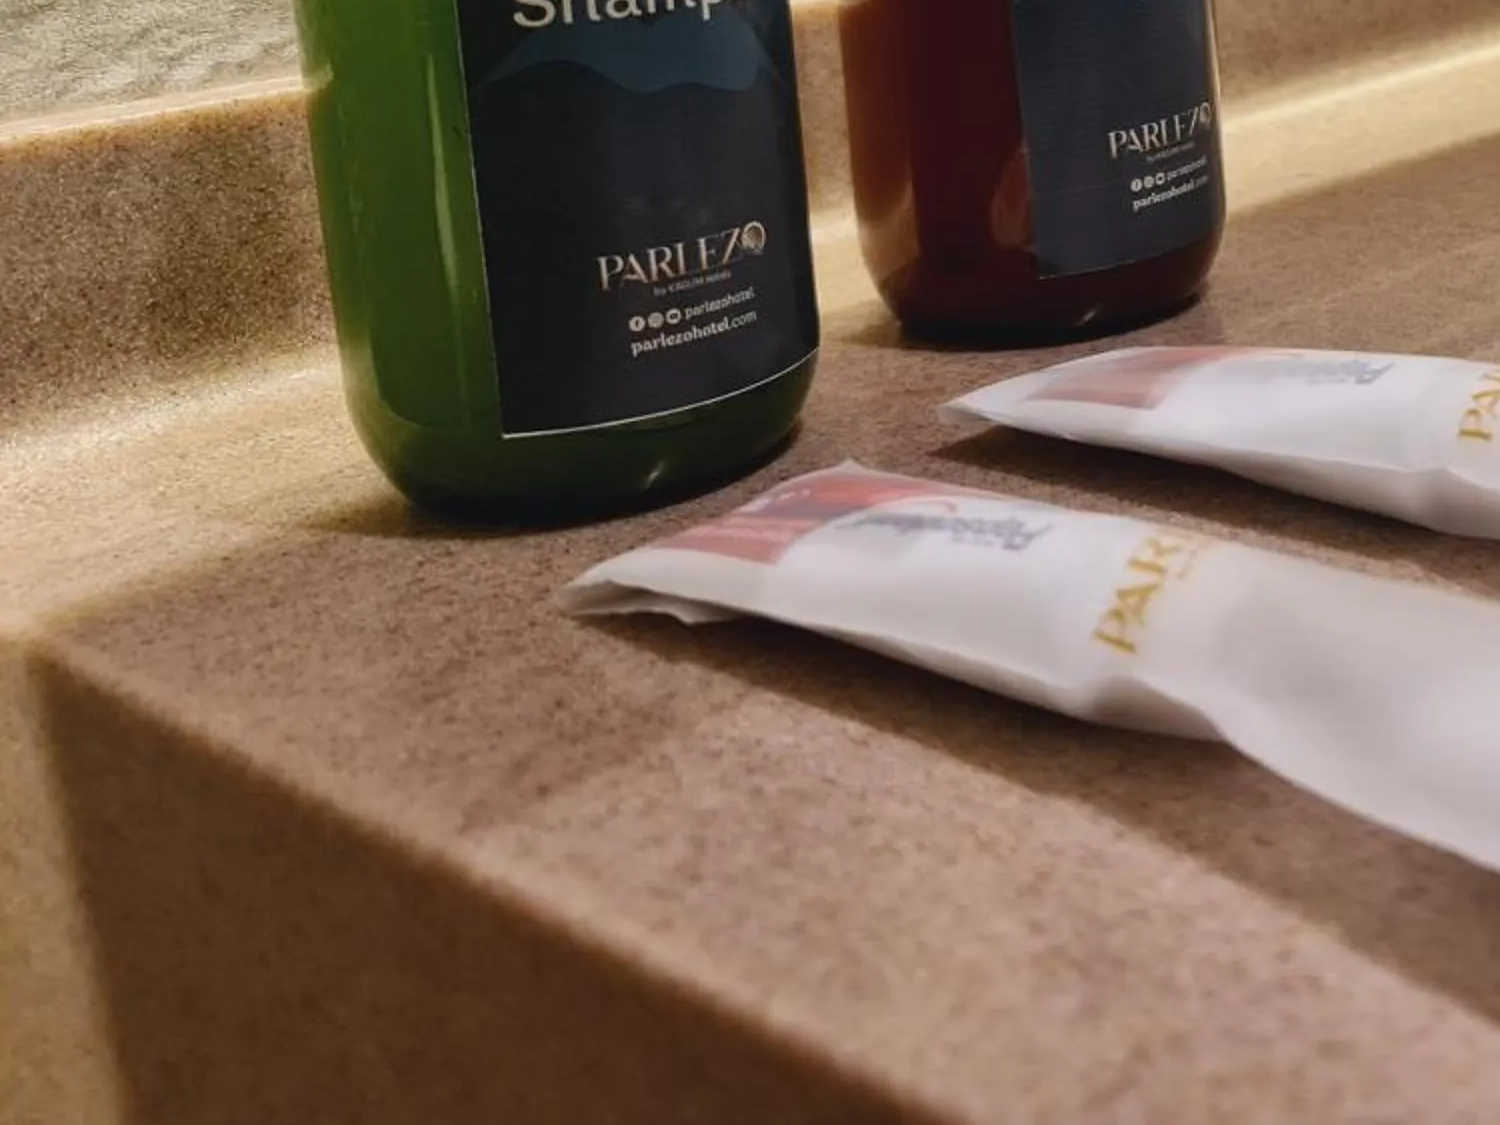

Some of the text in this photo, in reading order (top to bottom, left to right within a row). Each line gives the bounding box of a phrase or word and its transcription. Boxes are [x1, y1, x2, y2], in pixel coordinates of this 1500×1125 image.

[597, 220, 767, 293] PARLEZO
[630, 311, 758, 358] parlezohotel.com
[1091, 537, 1183, 655] PAR
